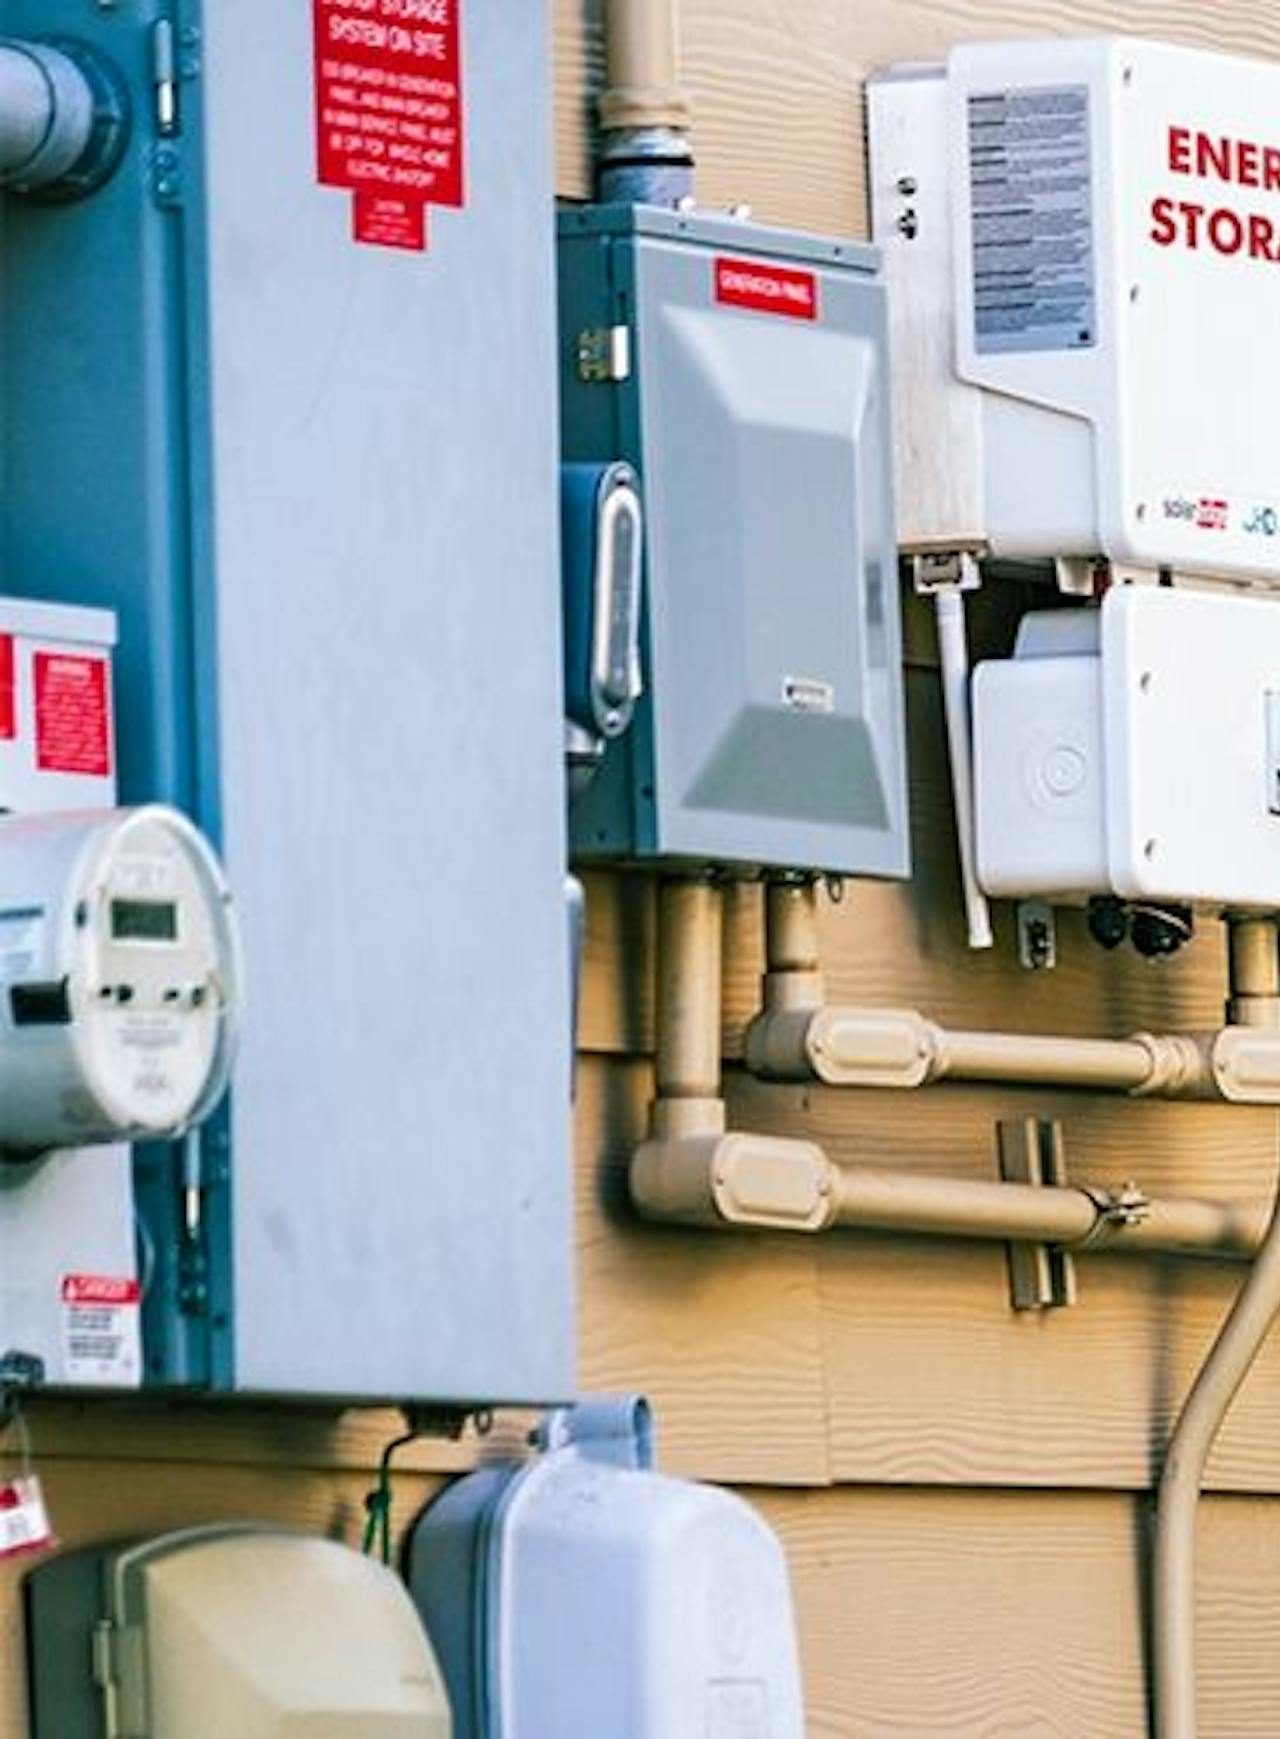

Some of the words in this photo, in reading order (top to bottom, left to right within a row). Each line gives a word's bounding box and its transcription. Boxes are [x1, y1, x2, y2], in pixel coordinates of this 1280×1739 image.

[329, 15, 387, 47] SYSTEM
[388, 25, 412, 52] ON
[412, 30, 447, 61] SITE
